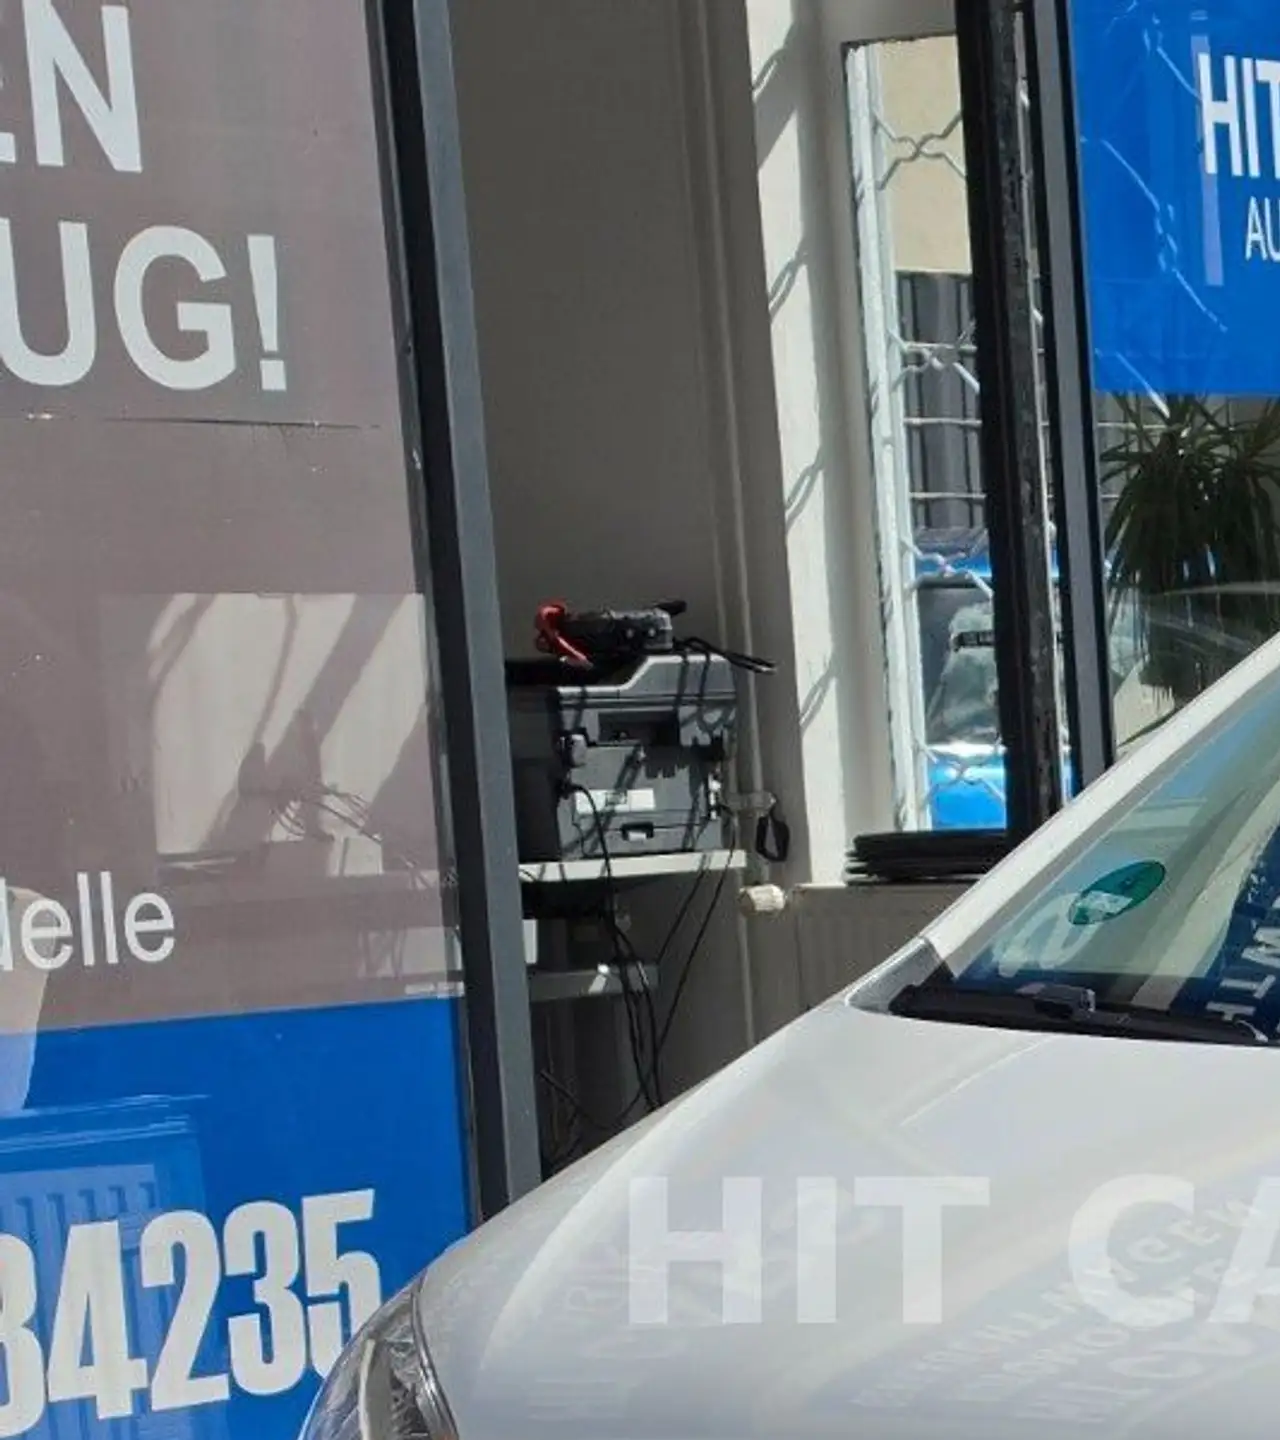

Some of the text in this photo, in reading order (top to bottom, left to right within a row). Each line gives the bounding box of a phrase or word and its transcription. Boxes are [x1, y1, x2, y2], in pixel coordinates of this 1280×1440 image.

[0, 0, 143, 172] N
[0, 217, 287, 392] UG!
[0, 871, 175, 971] elle
